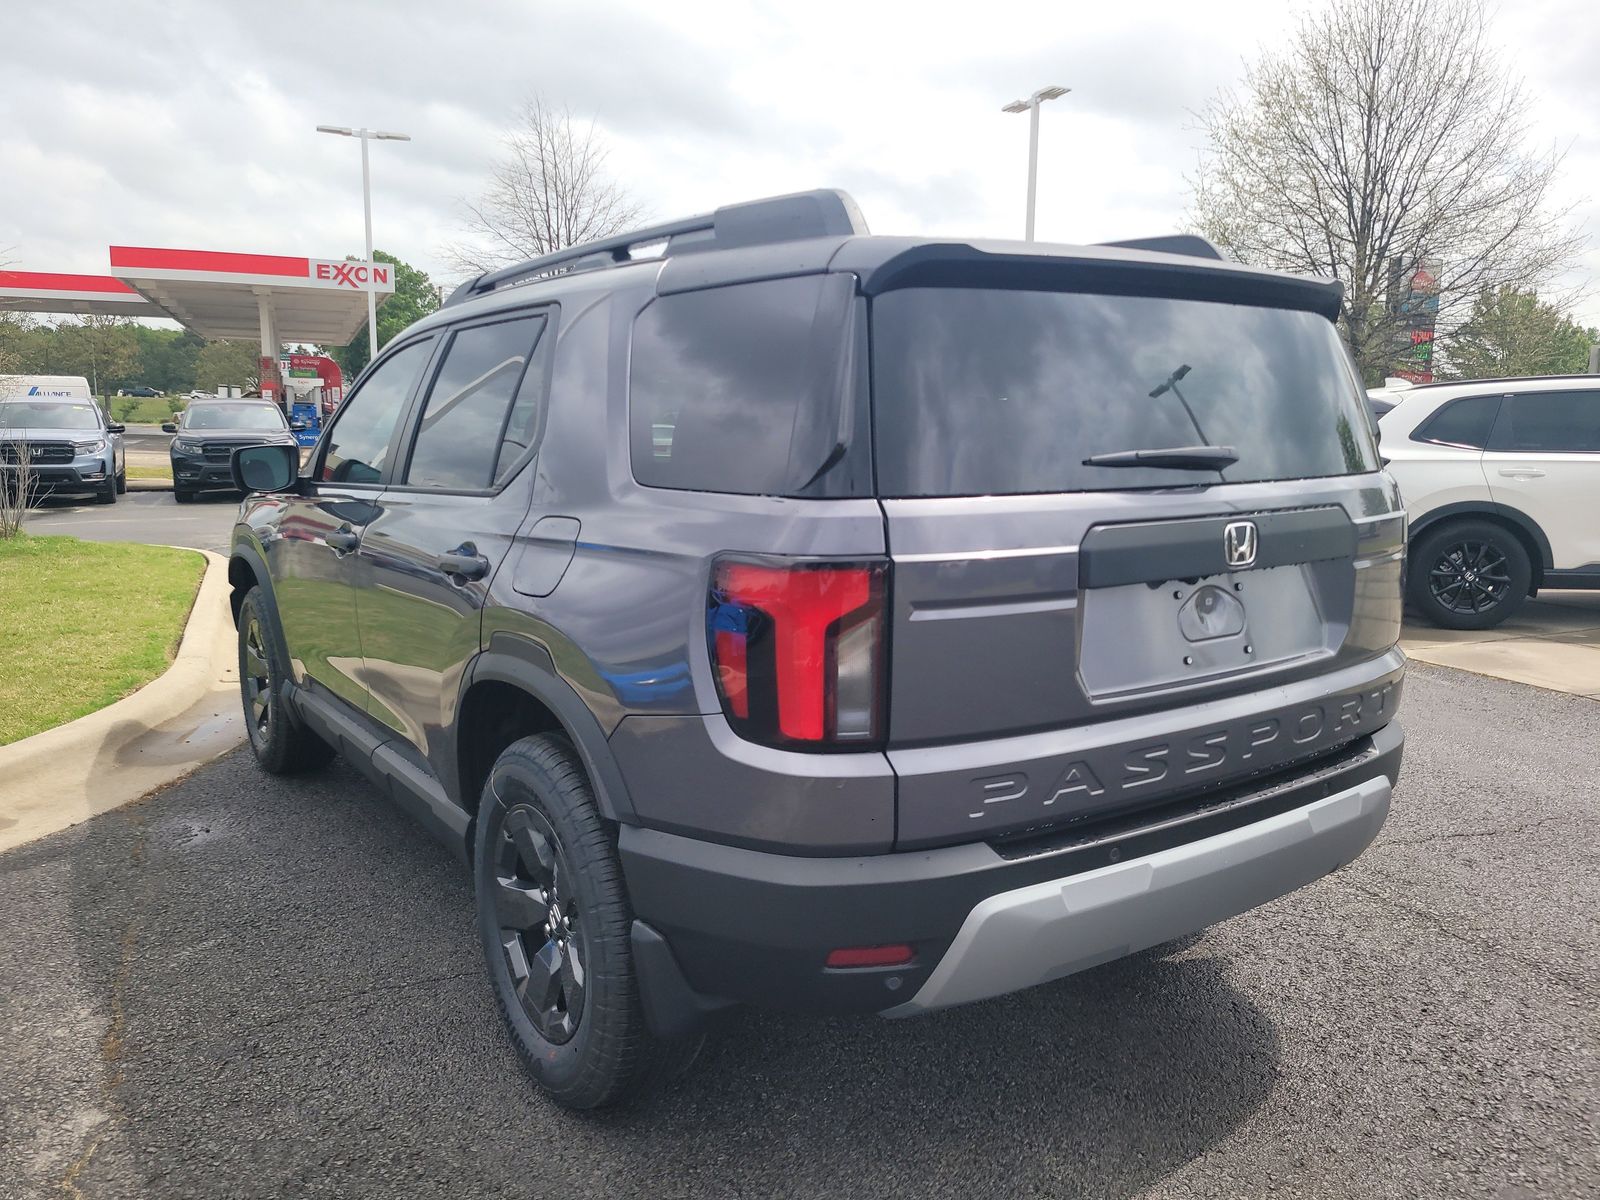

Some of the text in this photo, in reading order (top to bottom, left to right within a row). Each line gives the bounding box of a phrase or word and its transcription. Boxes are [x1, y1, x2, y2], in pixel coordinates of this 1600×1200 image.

[316, 263, 388, 289] EXXON
[299, 433, 321, 442] Synerg
[968, 684, 1393, 821] PASSPORT
